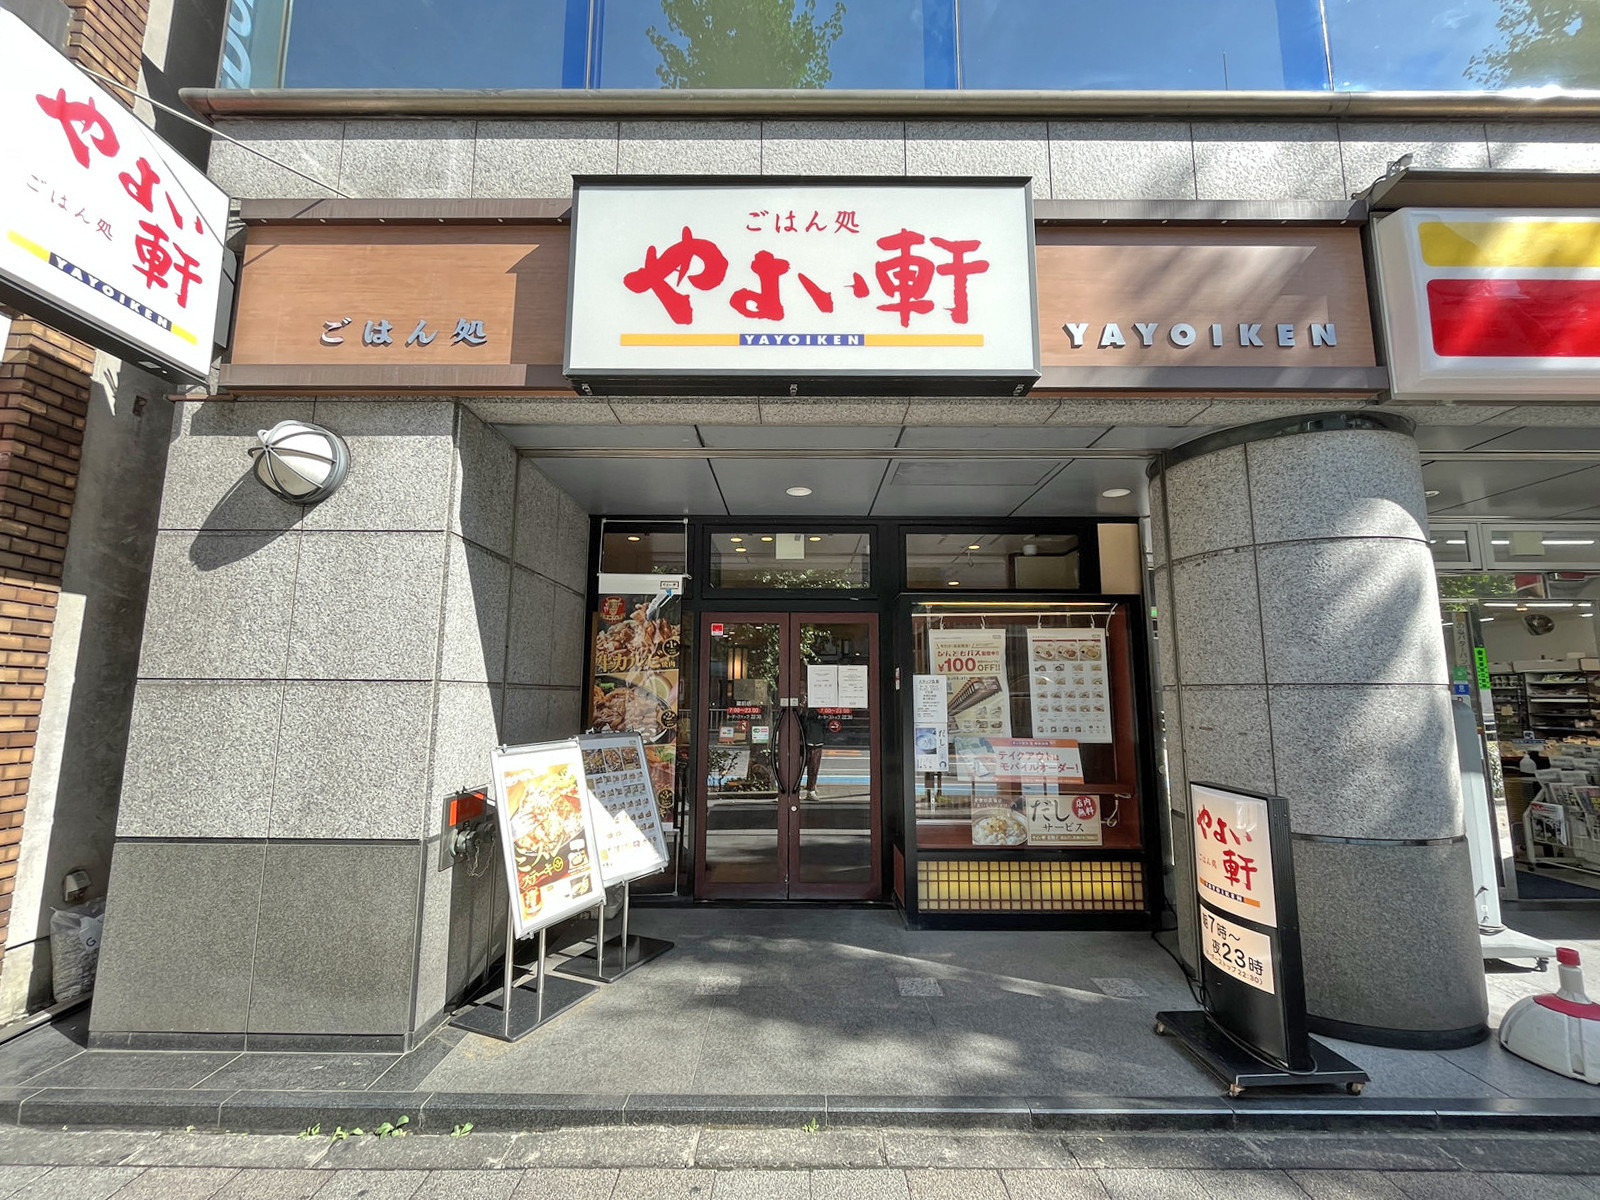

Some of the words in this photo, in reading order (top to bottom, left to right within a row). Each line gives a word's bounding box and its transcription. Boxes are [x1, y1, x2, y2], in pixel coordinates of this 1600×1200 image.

[26, 174, 113, 242] ごはん処
[745, 209, 861, 234] ごはん処
[623, 226, 990, 327] やよい軒
[53, 255, 171, 329] YAYOIKEN
[319, 317, 487, 347] ごはん処
[744, 334, 861, 345] YAYOIKEN
[1063, 322, 1338, 349] YAYOIKEN
[938, 657, 976, 672] ¥100
[977, 663, 1001, 672] OFF!!
[998, 751, 1060, 761] テイクアウトは
[1030, 799, 1070, 822] だし
[1042, 823, 1084, 833] サービス
[1211, 938, 1264, 976] 夜23時
